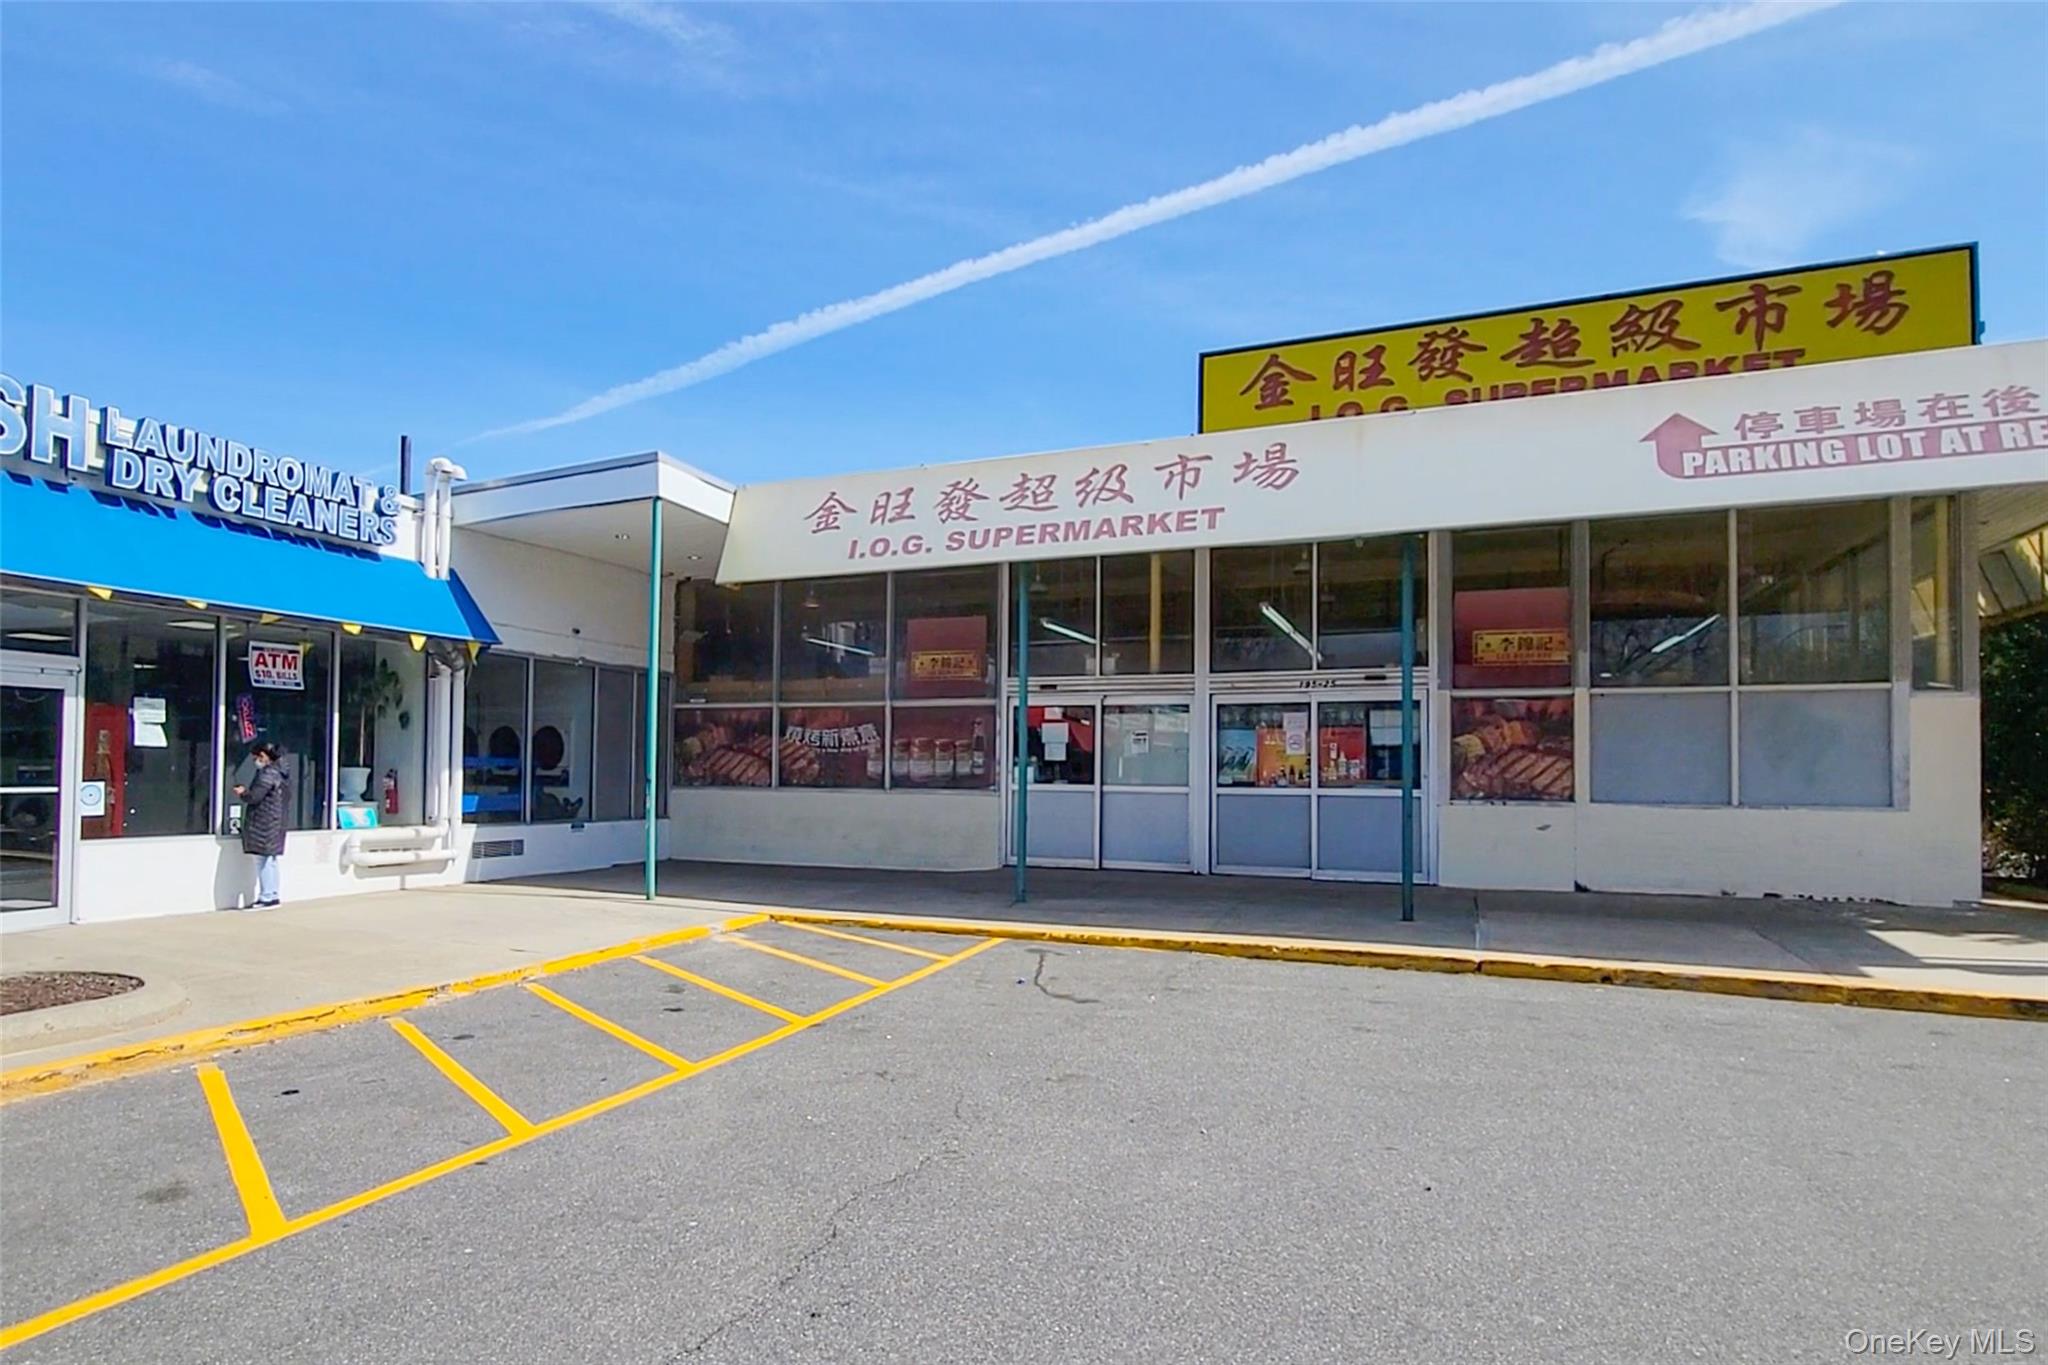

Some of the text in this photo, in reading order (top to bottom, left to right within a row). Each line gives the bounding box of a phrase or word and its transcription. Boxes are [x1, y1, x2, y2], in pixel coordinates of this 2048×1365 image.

[102, 405, 402, 516] LAUNDROMAT &
[1682, 438, 1849, 478] PARKING
[1857, 430, 1926, 463] LOT
[1939, 425, 1987, 456] AT
[109, 447, 397, 546] DRY CLEANERS
[848, 507, 1226, 559] I.O.G. SUPERMARKET
[254, 652, 298, 671] ATM
